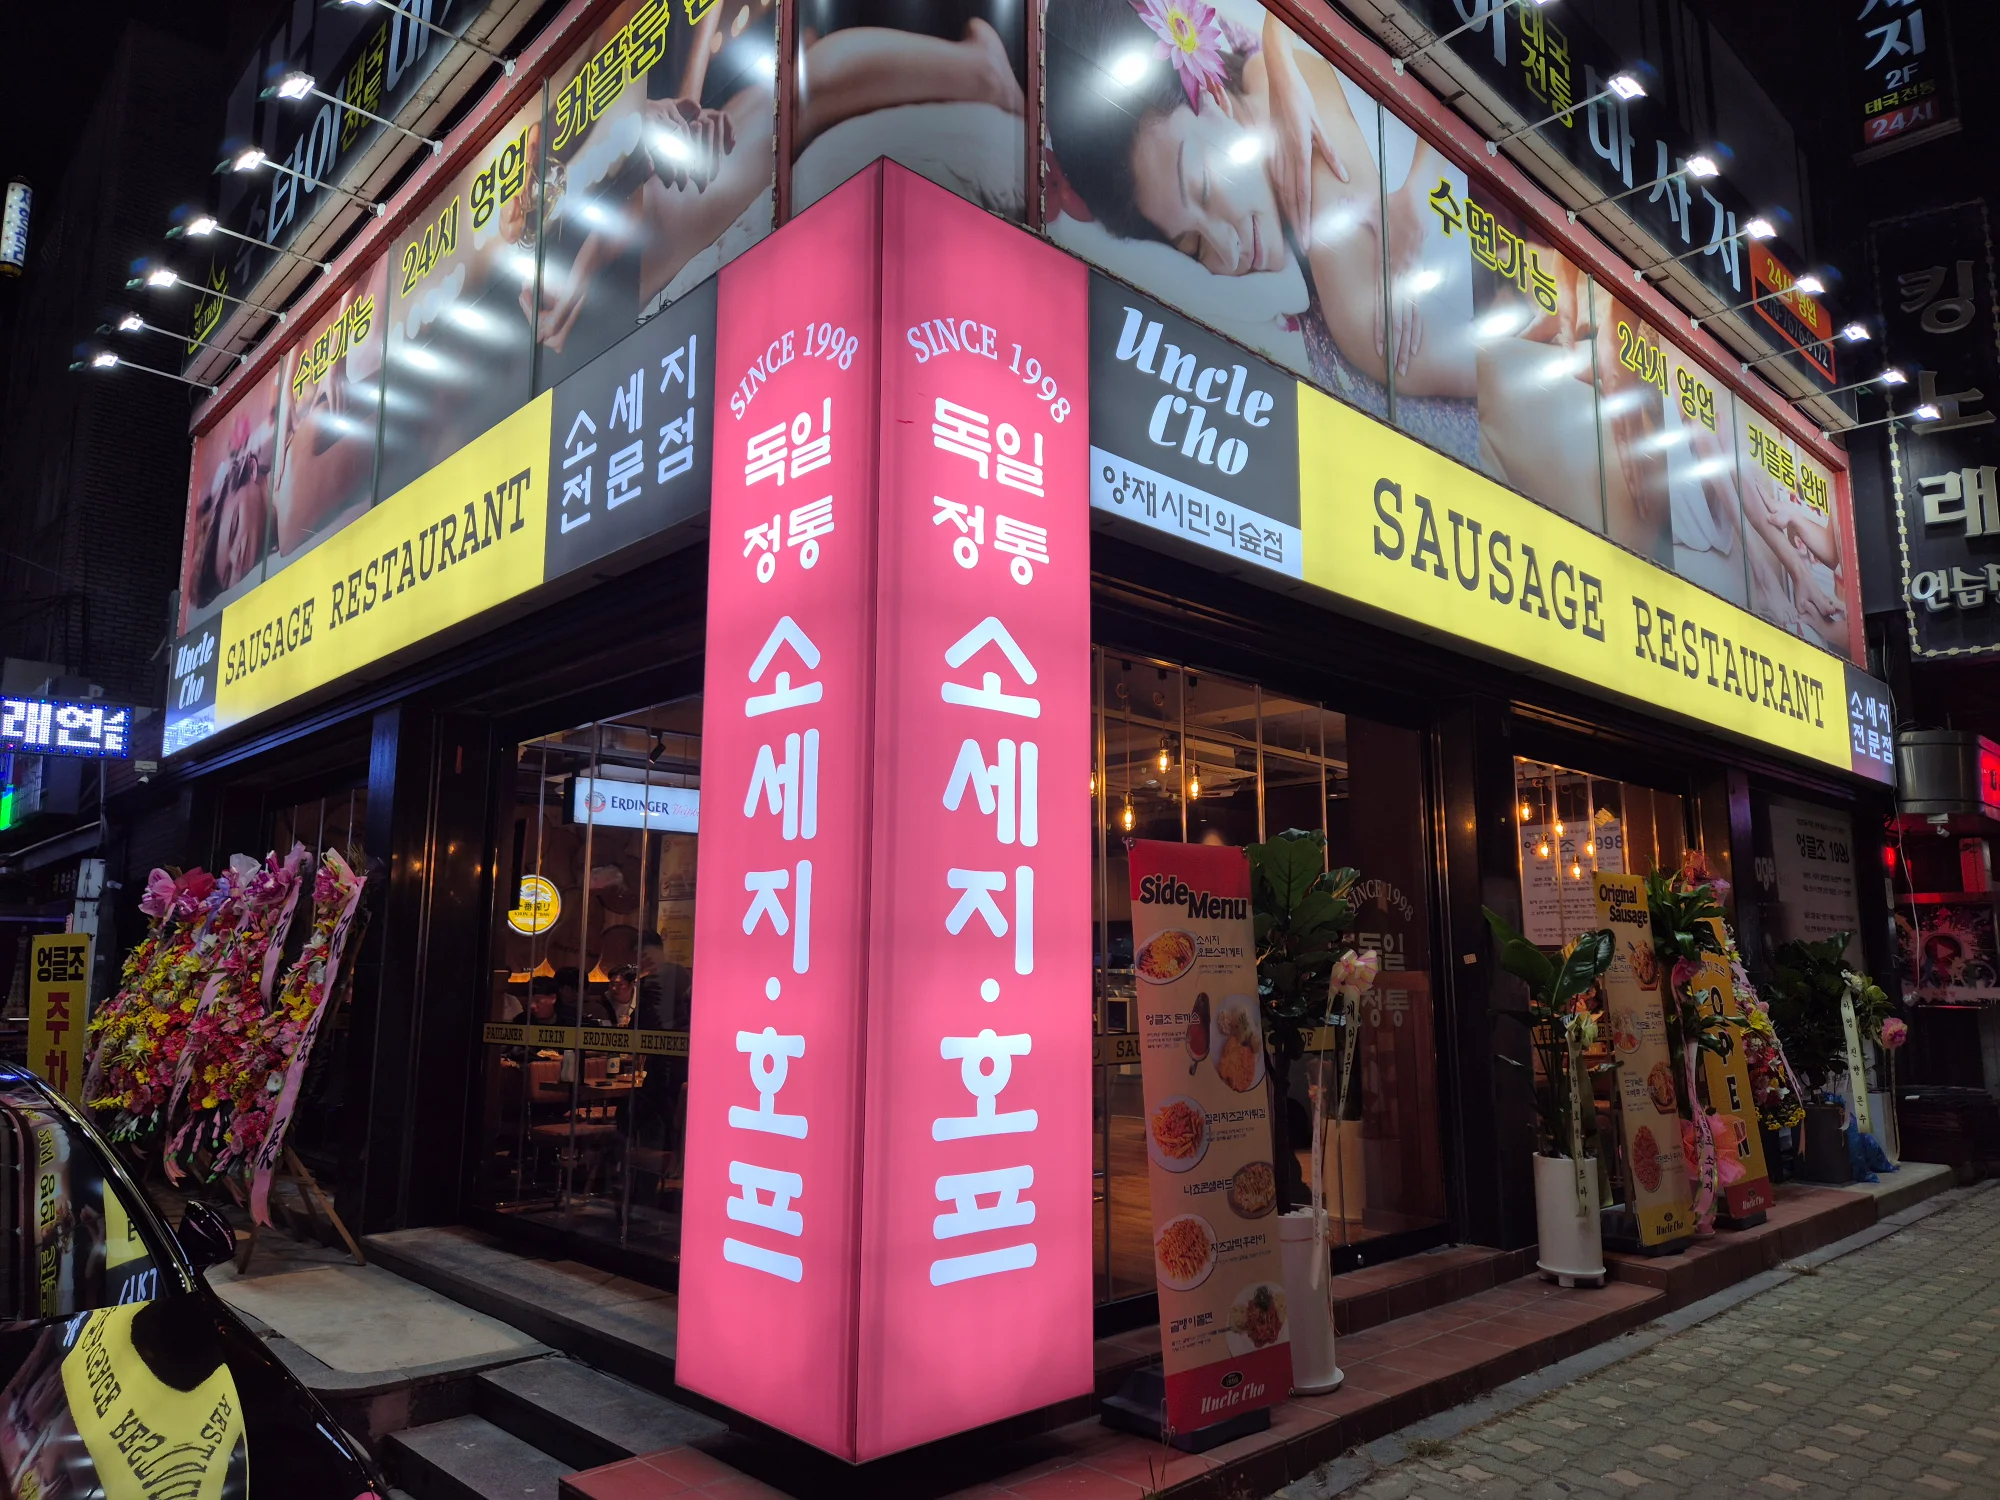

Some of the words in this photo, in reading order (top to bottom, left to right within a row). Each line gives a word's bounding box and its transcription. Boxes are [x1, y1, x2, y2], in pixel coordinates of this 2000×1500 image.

[1857, 0, 1926, 70] 지
[1885, 61, 1920, 90] 2F
[1872, 101, 1934, 140] 24시
[402, 194, 460, 298] 24시
[470, 125, 529, 231] 영업
[1429, 177, 1558, 316] 수면가능
[293, 293, 375, 399] 수면가능
[730, 329, 795, 420] SINCE
[803, 322, 858, 370] 1998
[907, 318, 998, 363] SINCE
[1008, 343, 1071, 424] 1998
[1115, 306, 1275, 427] Uncle
[1617, 320, 1670, 397] 24시
[1676, 366, 1719, 433] 영업
[563, 334, 697, 470] 소세지
[1148, 394, 1249, 475] Cho
[561, 406, 695, 535] 전문점
[745, 396, 832, 487] 독일
[932, 397, 1045, 497] 독일
[1747, 423, 1797, 493] 커플룸
[1800, 463, 1830, 516] 완비
[743, 495, 835, 583] 정통
[933, 495, 1049, 585] 정통
[1102, 465, 1283, 563] 양재시민의숲점
[225, 597, 315, 687] SAUSAGE
[329, 467, 531, 630] RESTAURANT
[1373, 477, 1606, 643] SAUSAGE
[1632, 595, 1825, 730] RESTAURANT
[174, 631, 215, 679] Uncle
[178, 672, 205, 710] Cho
[1851, 691, 1891, 733] 소세지
[1852, 723, 1893, 765] 전문점
[611, 796, 669, 815] ERDINGER
[1797, 833, 1827, 861] 엉클조
[1139, 873, 1188, 905] Side
[1188, 890, 1248, 920] Menu
[1386, 882, 1415, 923] 1998
[1599, 883, 1638, 908] Original
[1609, 904, 1649, 929] Sausage
[37, 945, 85, 983] 엉클조
[538, 1029, 565, 1044] KIRIN
[583, 1031, 630, 1048] ERDINGER
[640, 1034, 689, 1051] HEINEKE
[1146, 1013, 1173, 1025] 엉클조
[1174, 1012, 1200, 1025] 돈까스
[1362, 989, 1410, 1027] 정통
[1200, 1388, 1240, 1415] Uncle
[1241, 1381, 1265, 1403] Cho
